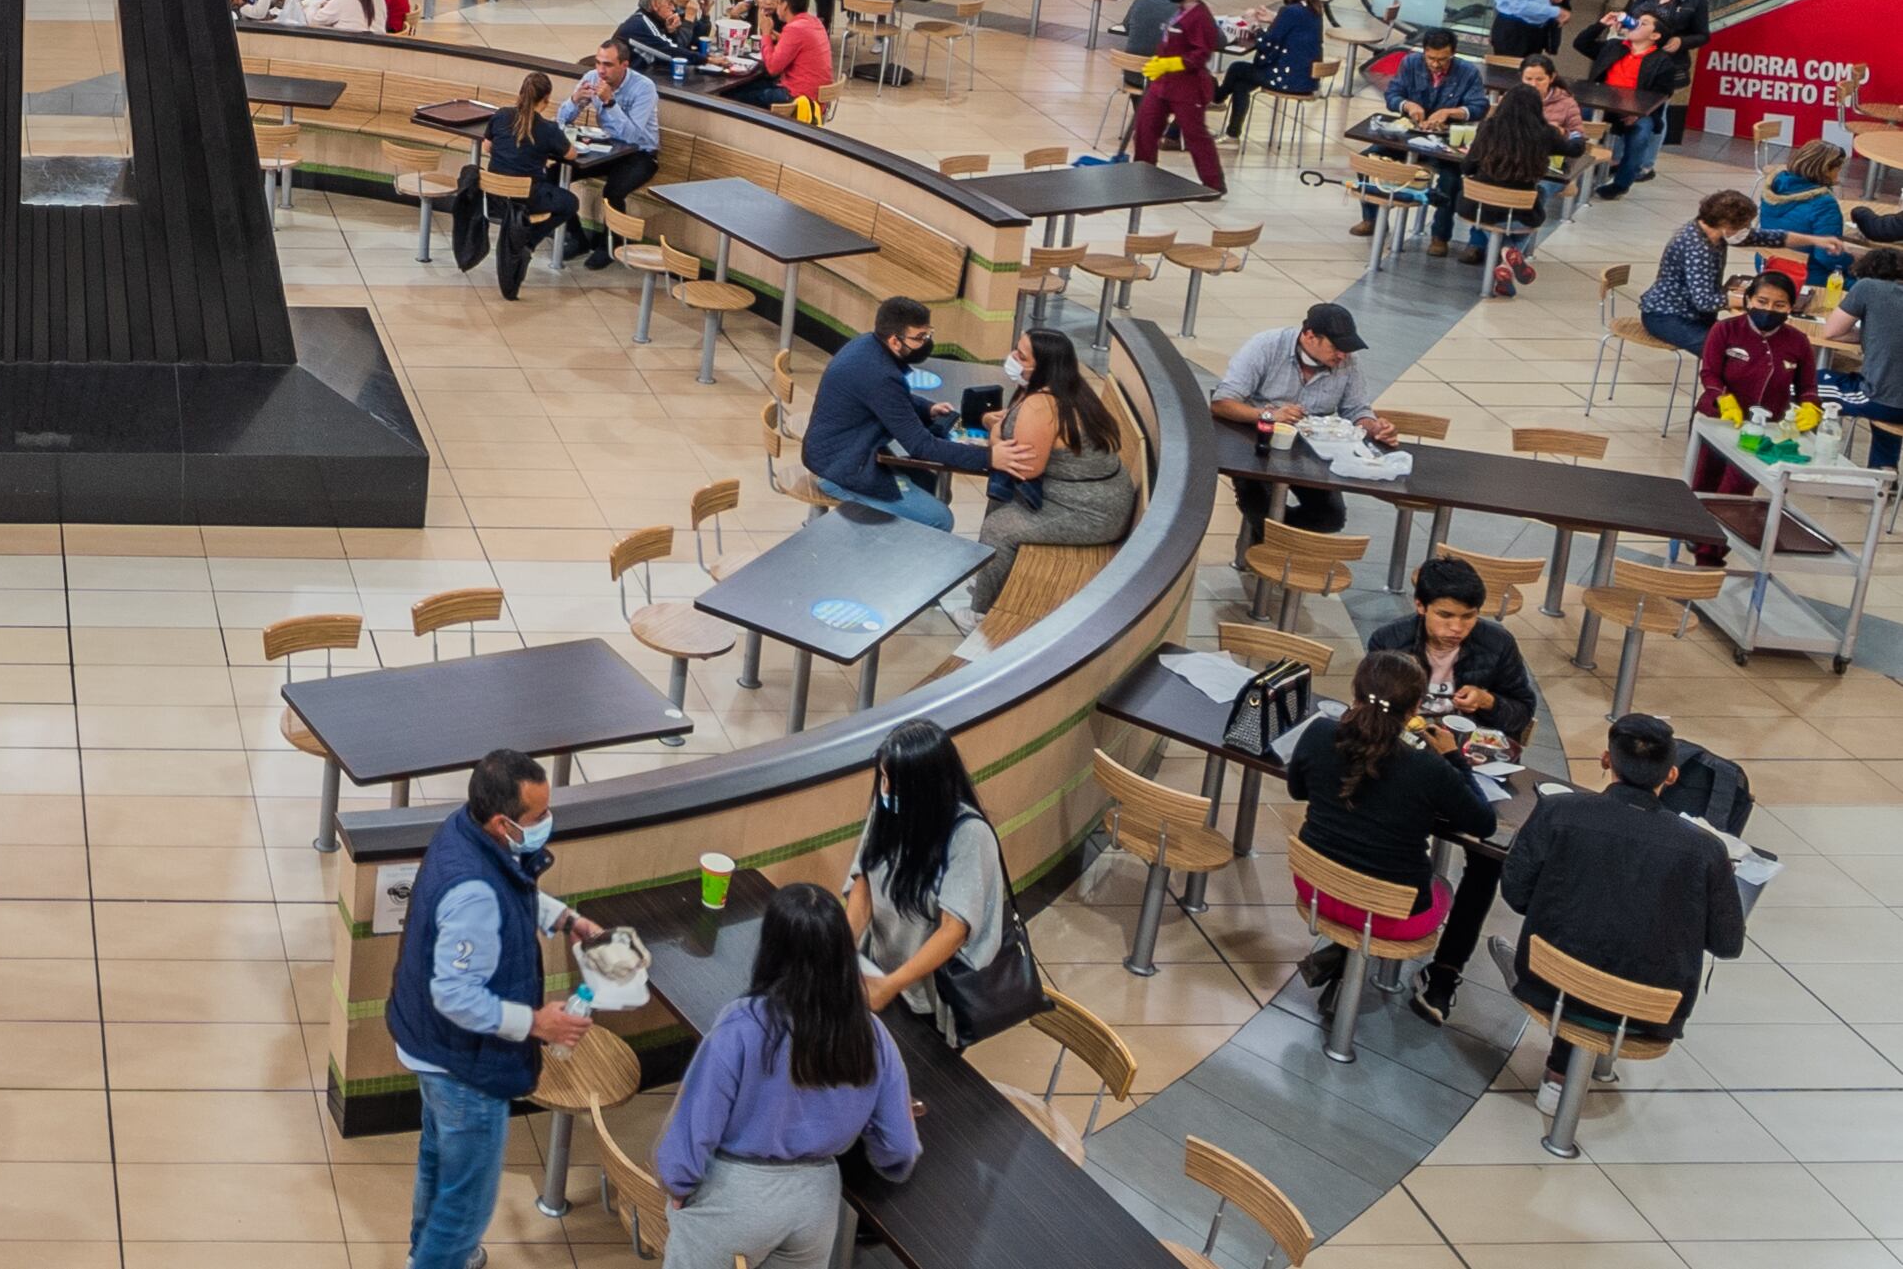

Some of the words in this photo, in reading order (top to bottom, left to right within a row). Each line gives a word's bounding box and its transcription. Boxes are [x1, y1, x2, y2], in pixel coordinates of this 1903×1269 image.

[1706, 50, 1799, 79] AHORRA
[1719, 75, 1818, 105] EXPERTO
[451, 939, 475, 970] 2
